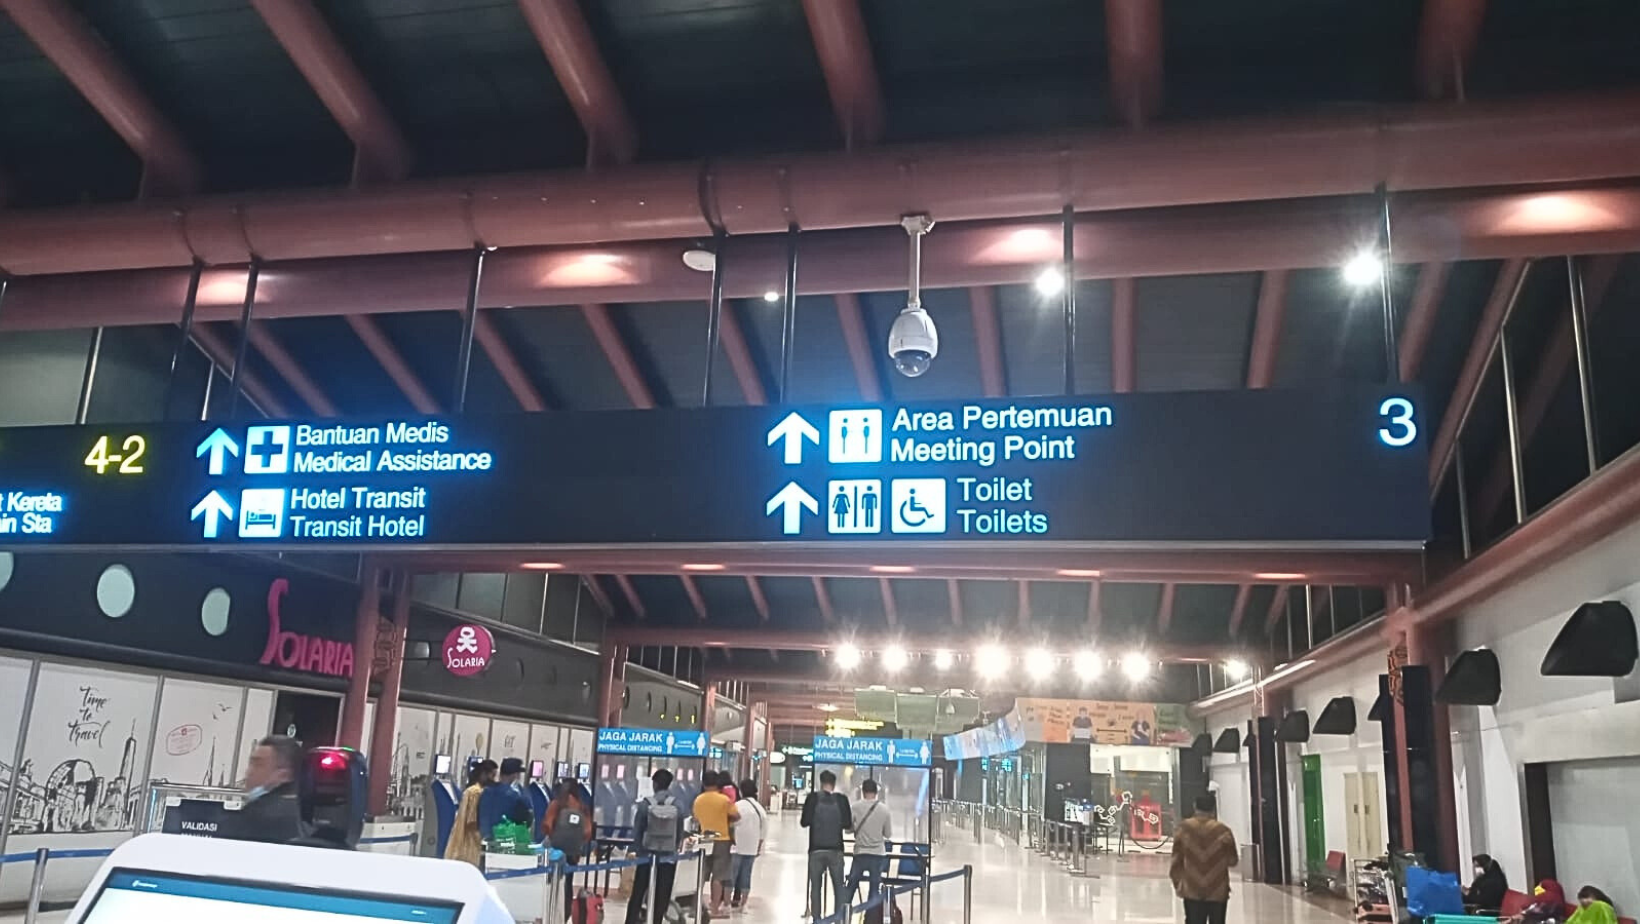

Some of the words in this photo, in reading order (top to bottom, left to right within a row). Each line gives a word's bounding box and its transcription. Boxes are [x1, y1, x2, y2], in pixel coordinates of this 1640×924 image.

[891, 407, 955, 431] Area
[963, 405, 1113, 430] Pertemuan
[1380, 398, 1417, 446] 3
[295, 424, 380, 446] Bantuan
[385, 421, 449, 444] Medis
[84, 434, 146, 474] 4-2
[293, 450, 372, 473] Medical
[376, 449, 492, 472] Assistance
[891, 436, 995, 466] Meeting
[1004, 434, 1076, 460] Point
[290, 487, 347, 510] Hotel
[351, 486, 427, 509] Transit
[956, 476, 1033, 501] Toilet
[6, 491, 63, 512] Kereta
[21, 511, 53, 534] Sta
[289, 515, 363, 538] Transit
[367, 514, 425, 537] Hotel
[956, 508, 1048, 534] Toilets
[259, 578, 354, 678] SOLARIA
[446, 646, 486, 669] SOLARIA
[597, 743, 627, 752] PHYSICAL
[599, 731, 627, 741] JAGA
[628, 732, 663, 743] JARAK
[814, 738, 844, 750] JAGA
[846, 739, 883, 751] JARAK
[814, 751, 844, 760] PHYSICAL
[181, 820, 218, 832] VALIDASI
